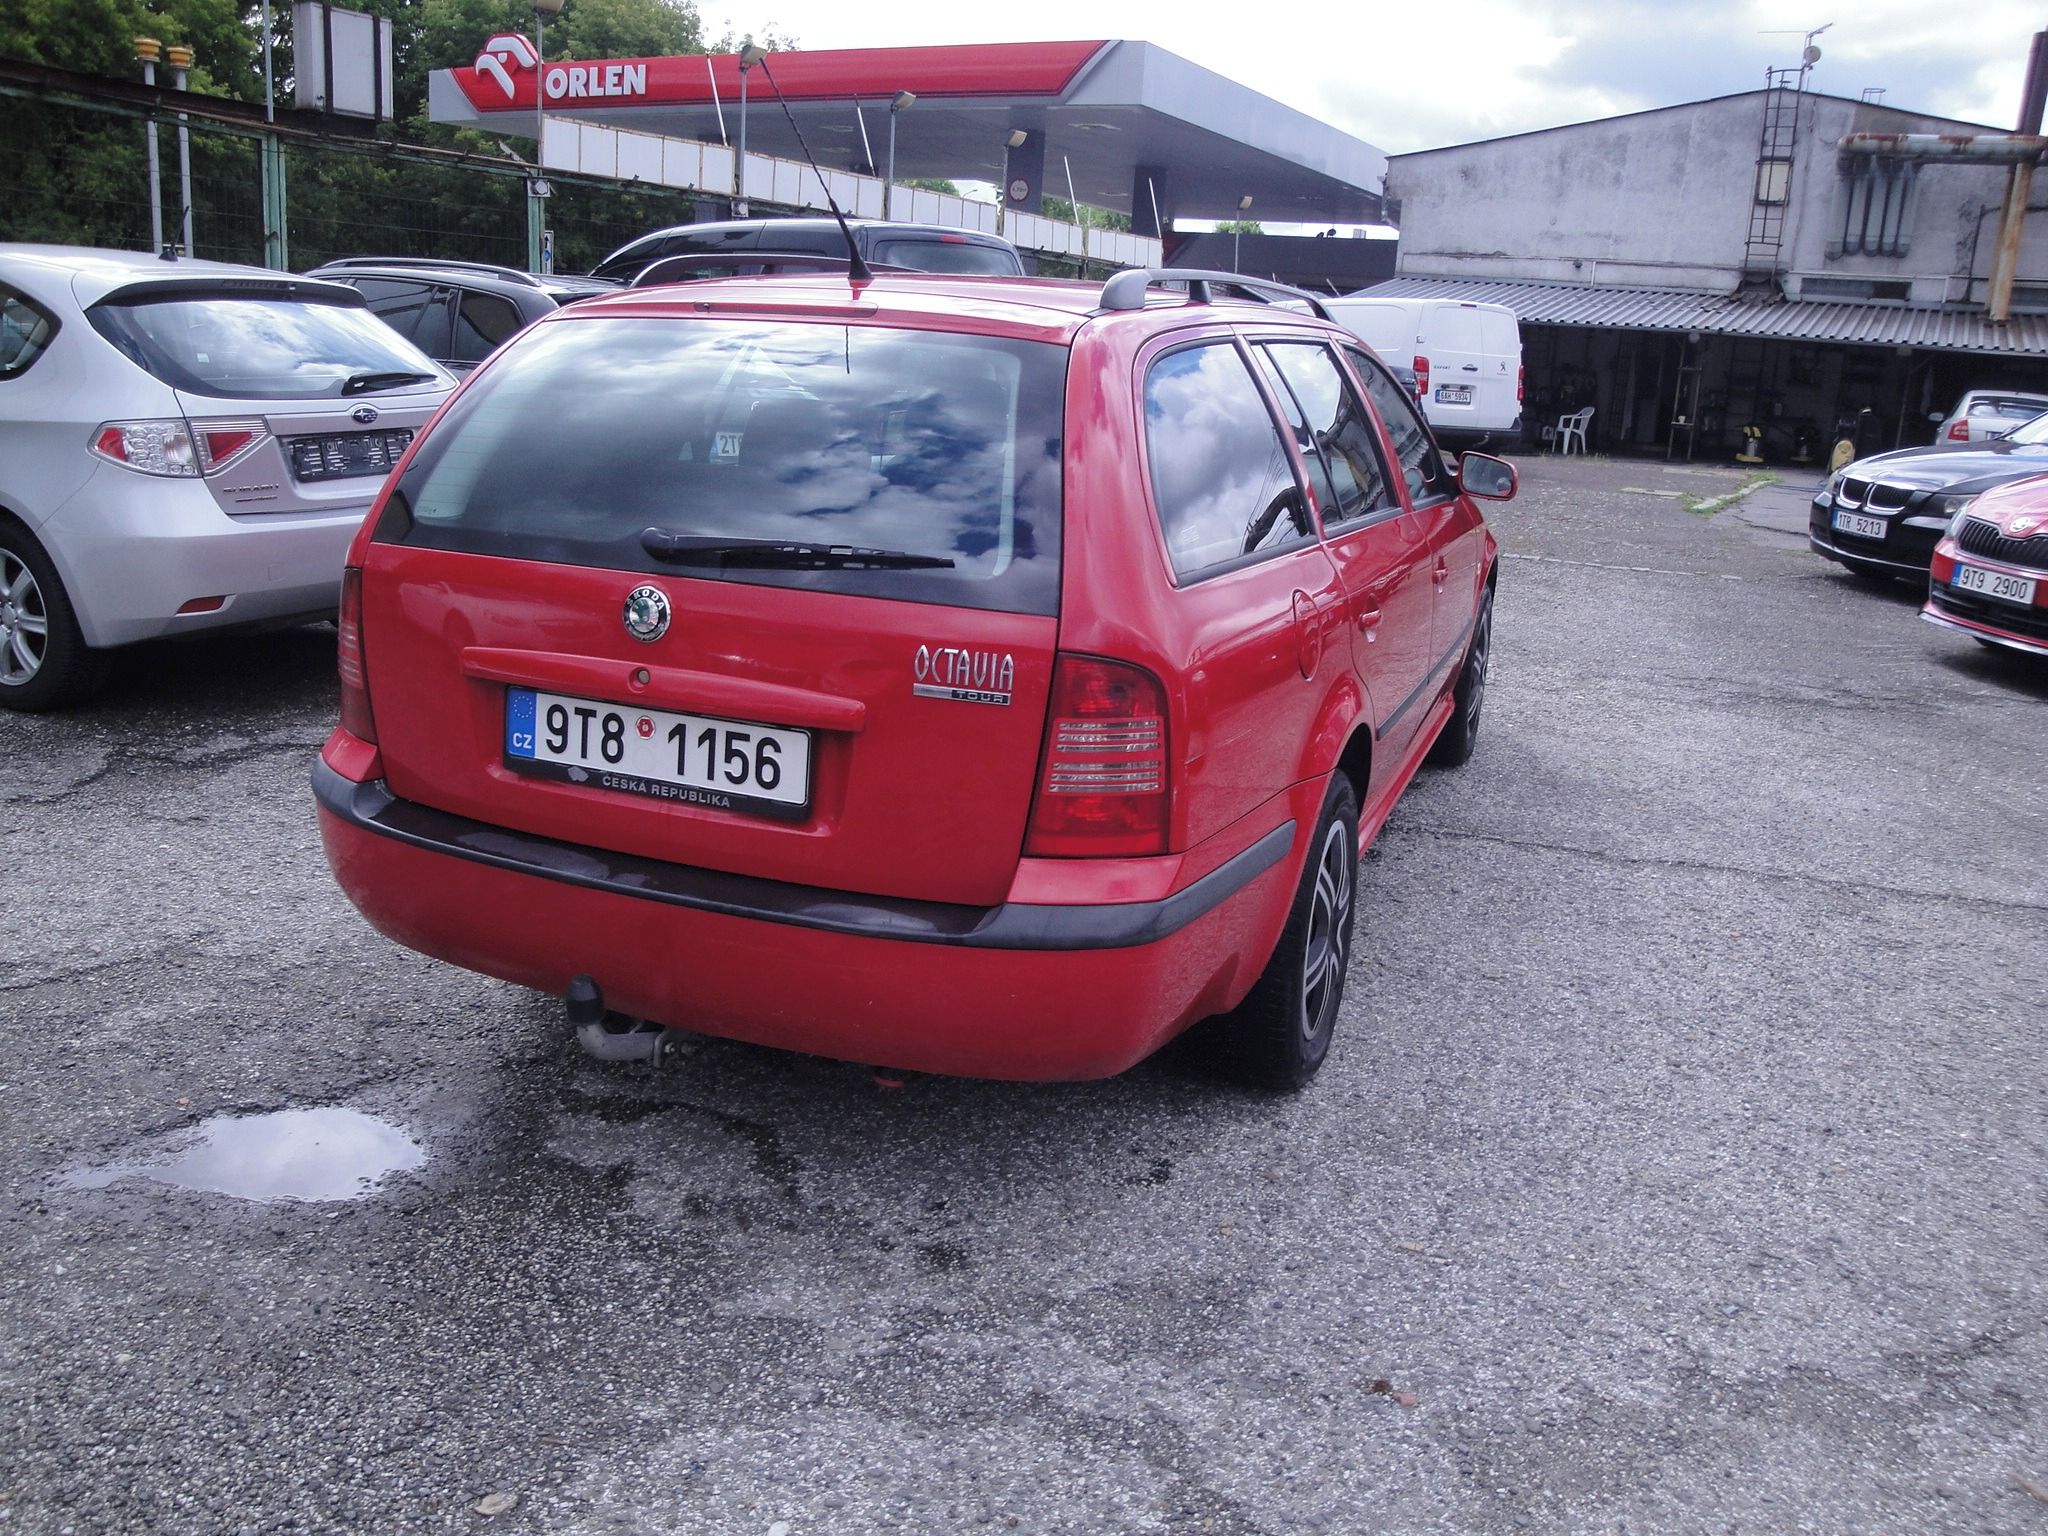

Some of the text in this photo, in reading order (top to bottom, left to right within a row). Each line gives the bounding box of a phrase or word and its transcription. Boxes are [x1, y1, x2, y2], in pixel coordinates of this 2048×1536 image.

[545, 64, 646, 99] ORLEN
[1839, 513, 1881, 535] 1TR 5213
[1962, 569, 2028, 598] 9T9 2900
[914, 644, 1014, 690] OCTAVIA
[956, 691, 1003, 703] TOUR
[512, 732, 533, 749] CZ
[546, 703, 782, 790] 9T8 1156
[651, 784, 731, 808] REPUBLIKA
